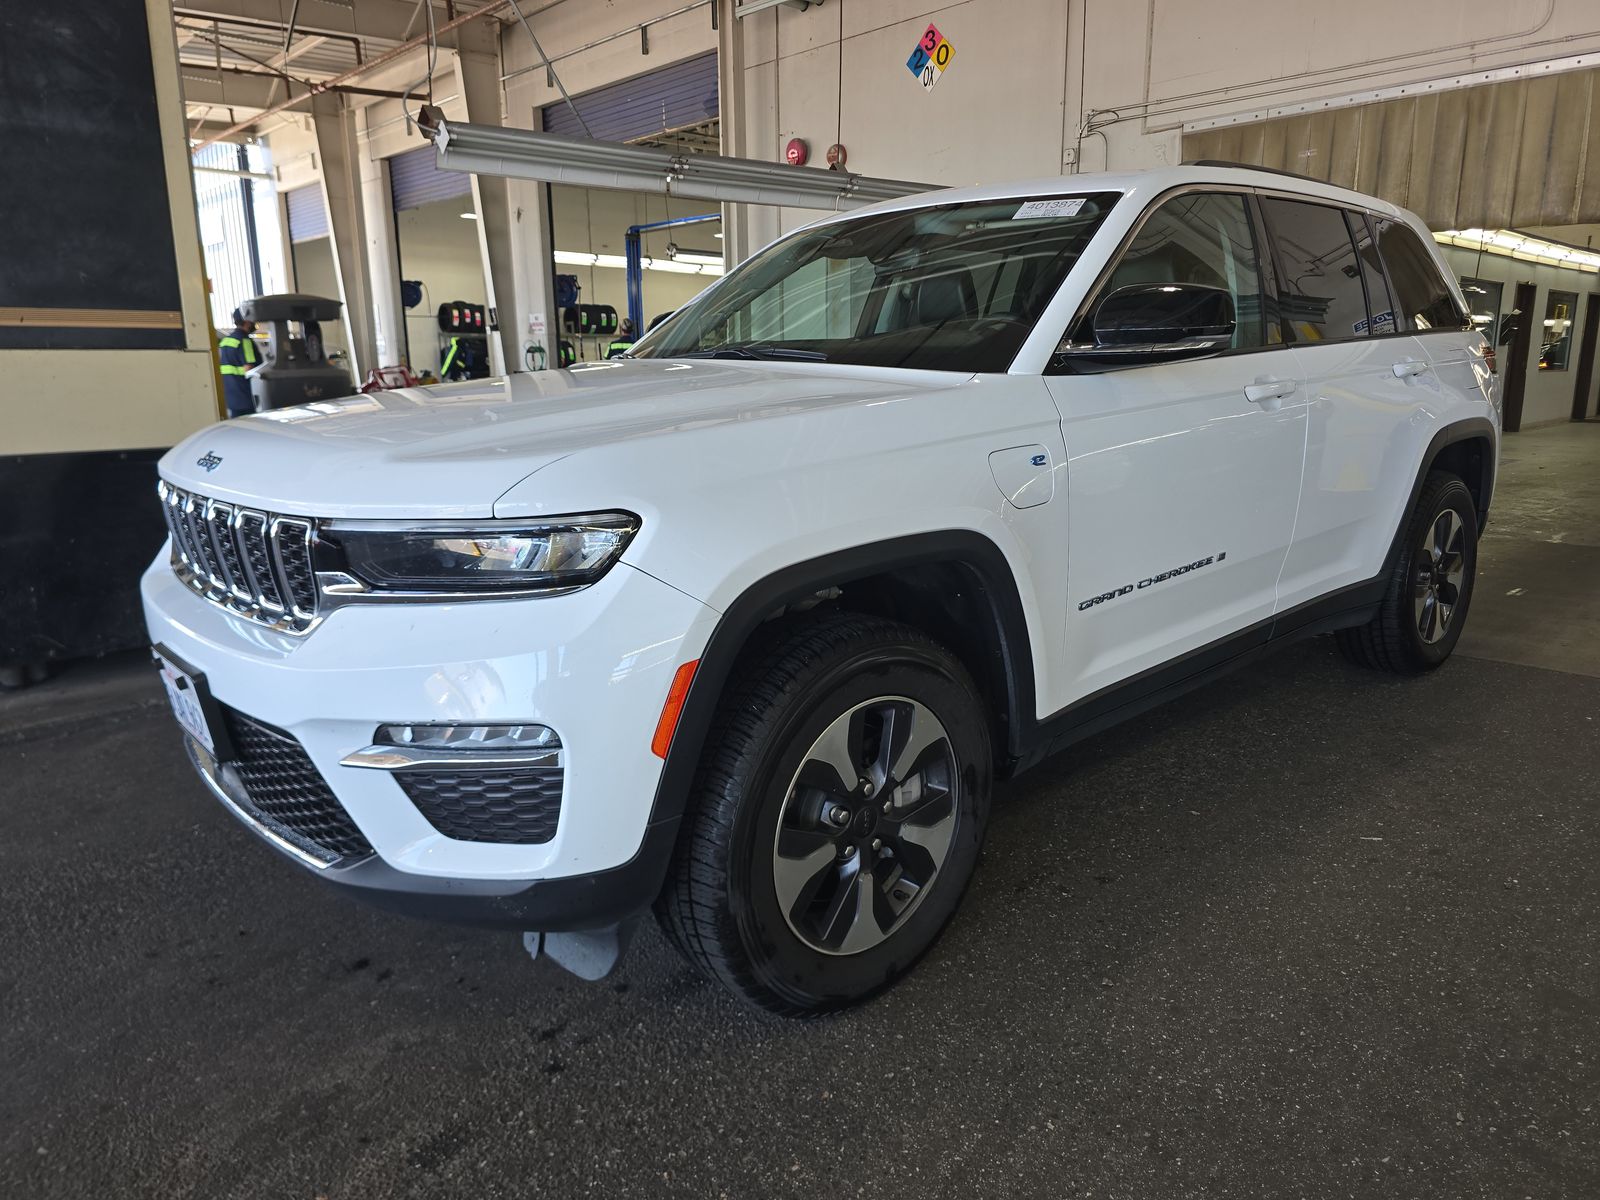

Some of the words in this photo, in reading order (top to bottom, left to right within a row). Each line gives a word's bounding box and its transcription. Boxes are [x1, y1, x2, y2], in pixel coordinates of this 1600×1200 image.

[925, 30, 936, 51] 3
[914, 48, 925, 69] 2
[936, 44, 949, 65] 0
[923, 66, 935, 87] OX
[1027, 200, 1084, 210] 4013874
[1078, 584, 1134, 611] GRAND
[1137, 556, 1214, 589] CHEROKEE
